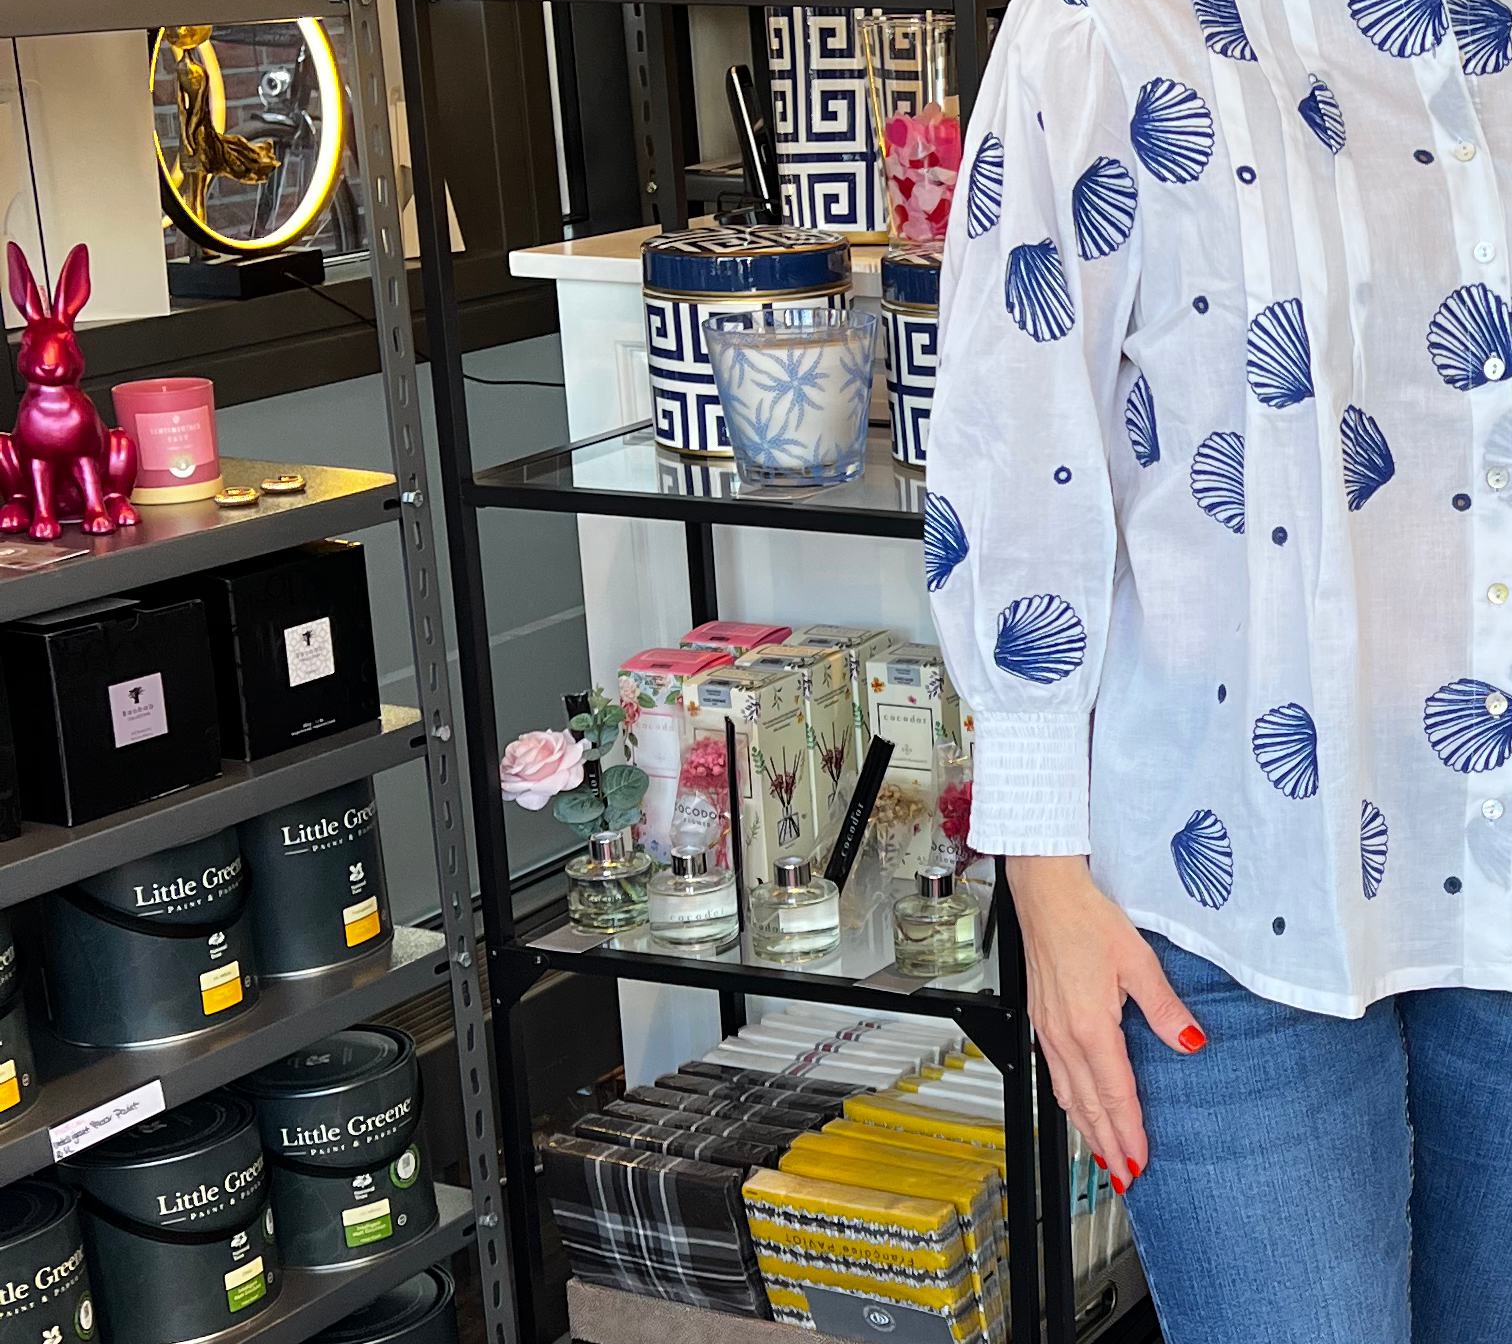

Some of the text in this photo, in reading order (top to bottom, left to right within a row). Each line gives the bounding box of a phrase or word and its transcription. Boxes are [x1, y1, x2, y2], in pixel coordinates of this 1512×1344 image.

[122, 703, 154, 717] Baobab
[281, 818, 339, 846] Little
[312, 838, 344, 853] PAINT
[134, 877, 197, 907] Little
[167, 899, 202, 914] PAINT
[280, 1097, 412, 1148] Little Greene
[310, 1142, 345, 1157] PAINT
[157, 1184, 219, 1216] Little
[190, 1203, 225, 1221] PAINT
